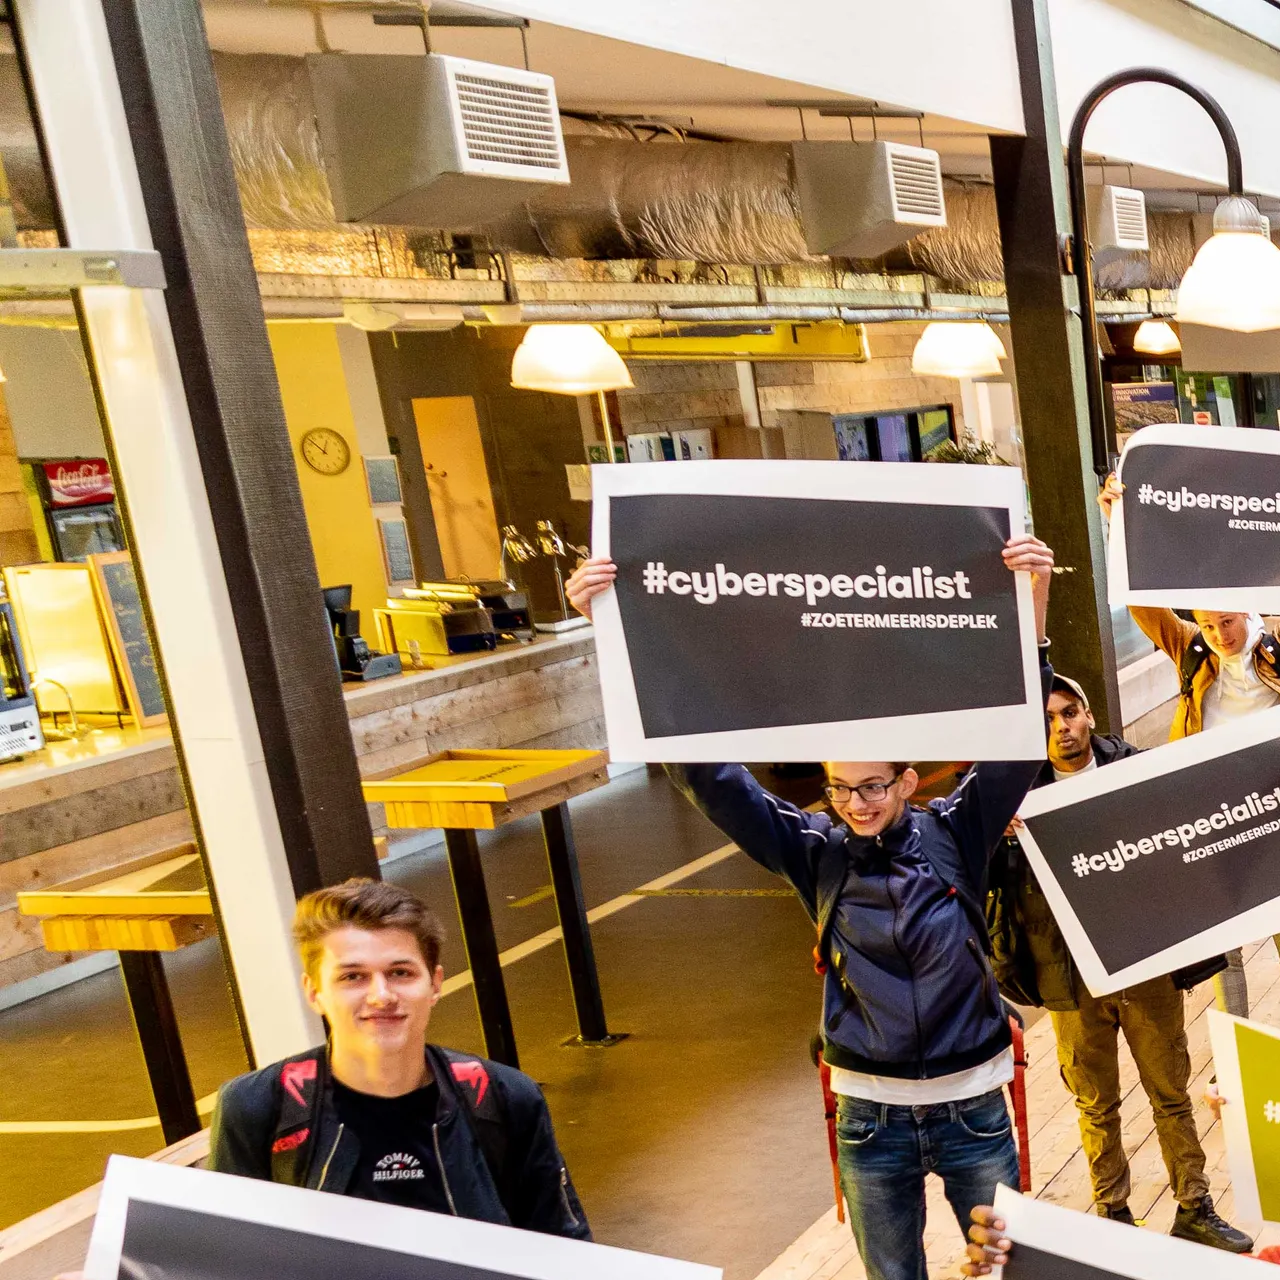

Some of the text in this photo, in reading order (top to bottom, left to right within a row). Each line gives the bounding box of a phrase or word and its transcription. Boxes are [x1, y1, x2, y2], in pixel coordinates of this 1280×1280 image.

[643, 562, 970, 605] #cyberspecialist
[801, 610, 998, 629] #ZOETERMEERISDEPLEK
[376, 1152, 420, 1169] TOMMY
[373, 1168, 424, 1181] HILFIGER
